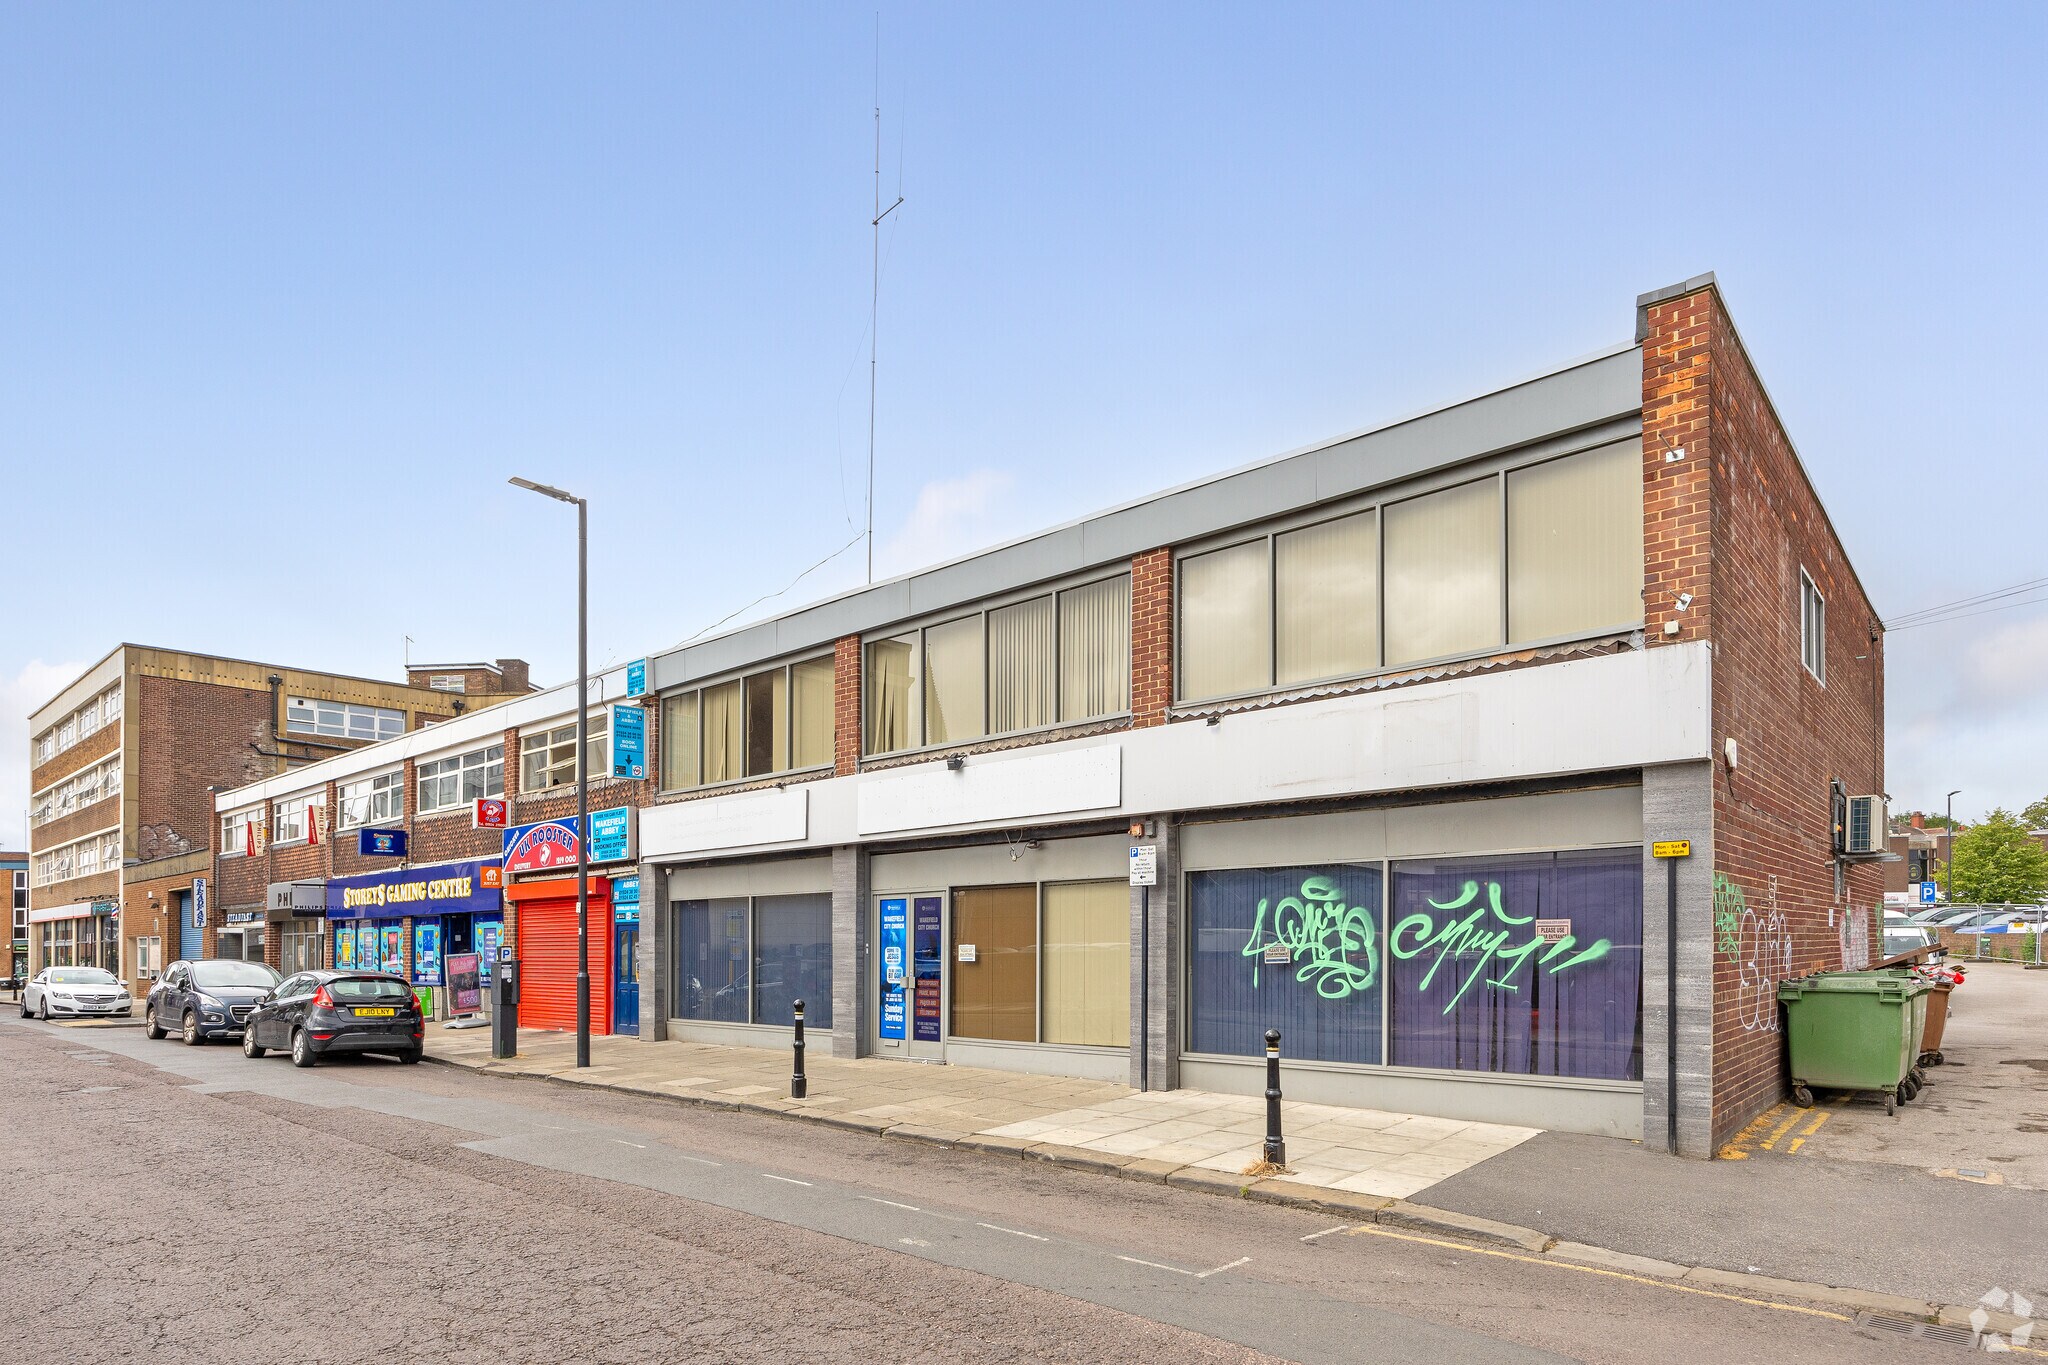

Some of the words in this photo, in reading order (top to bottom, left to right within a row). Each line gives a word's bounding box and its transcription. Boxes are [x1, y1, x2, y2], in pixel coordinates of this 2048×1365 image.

[616, 708, 643, 716] WAKEFIELD
[595, 817, 626, 829] WAKEFIELD
[601, 826, 620, 836] ABBEY
[518, 836, 532, 858] UK
[532, 827, 573, 852] ROOSTER
[1132, 849, 1138, 857] P
[622, 881, 639, 889] ABBEY
[343, 883, 386, 909] STOREYS
[386, 881, 427, 903] GAMING
[427, 876, 472, 899] CENTRE
[1923, 887, 1934, 900] P
[196, 879, 205, 927] STEADFAST
[227, 912, 253, 922] STEADFAST
[503, 949, 510, 958] P
[463, 996, 477, 1005] £500
[376, 1008, 390, 1016] LNY
[884, 1003, 903, 1015] Sunday
[884, 1013, 904, 1022] Service
